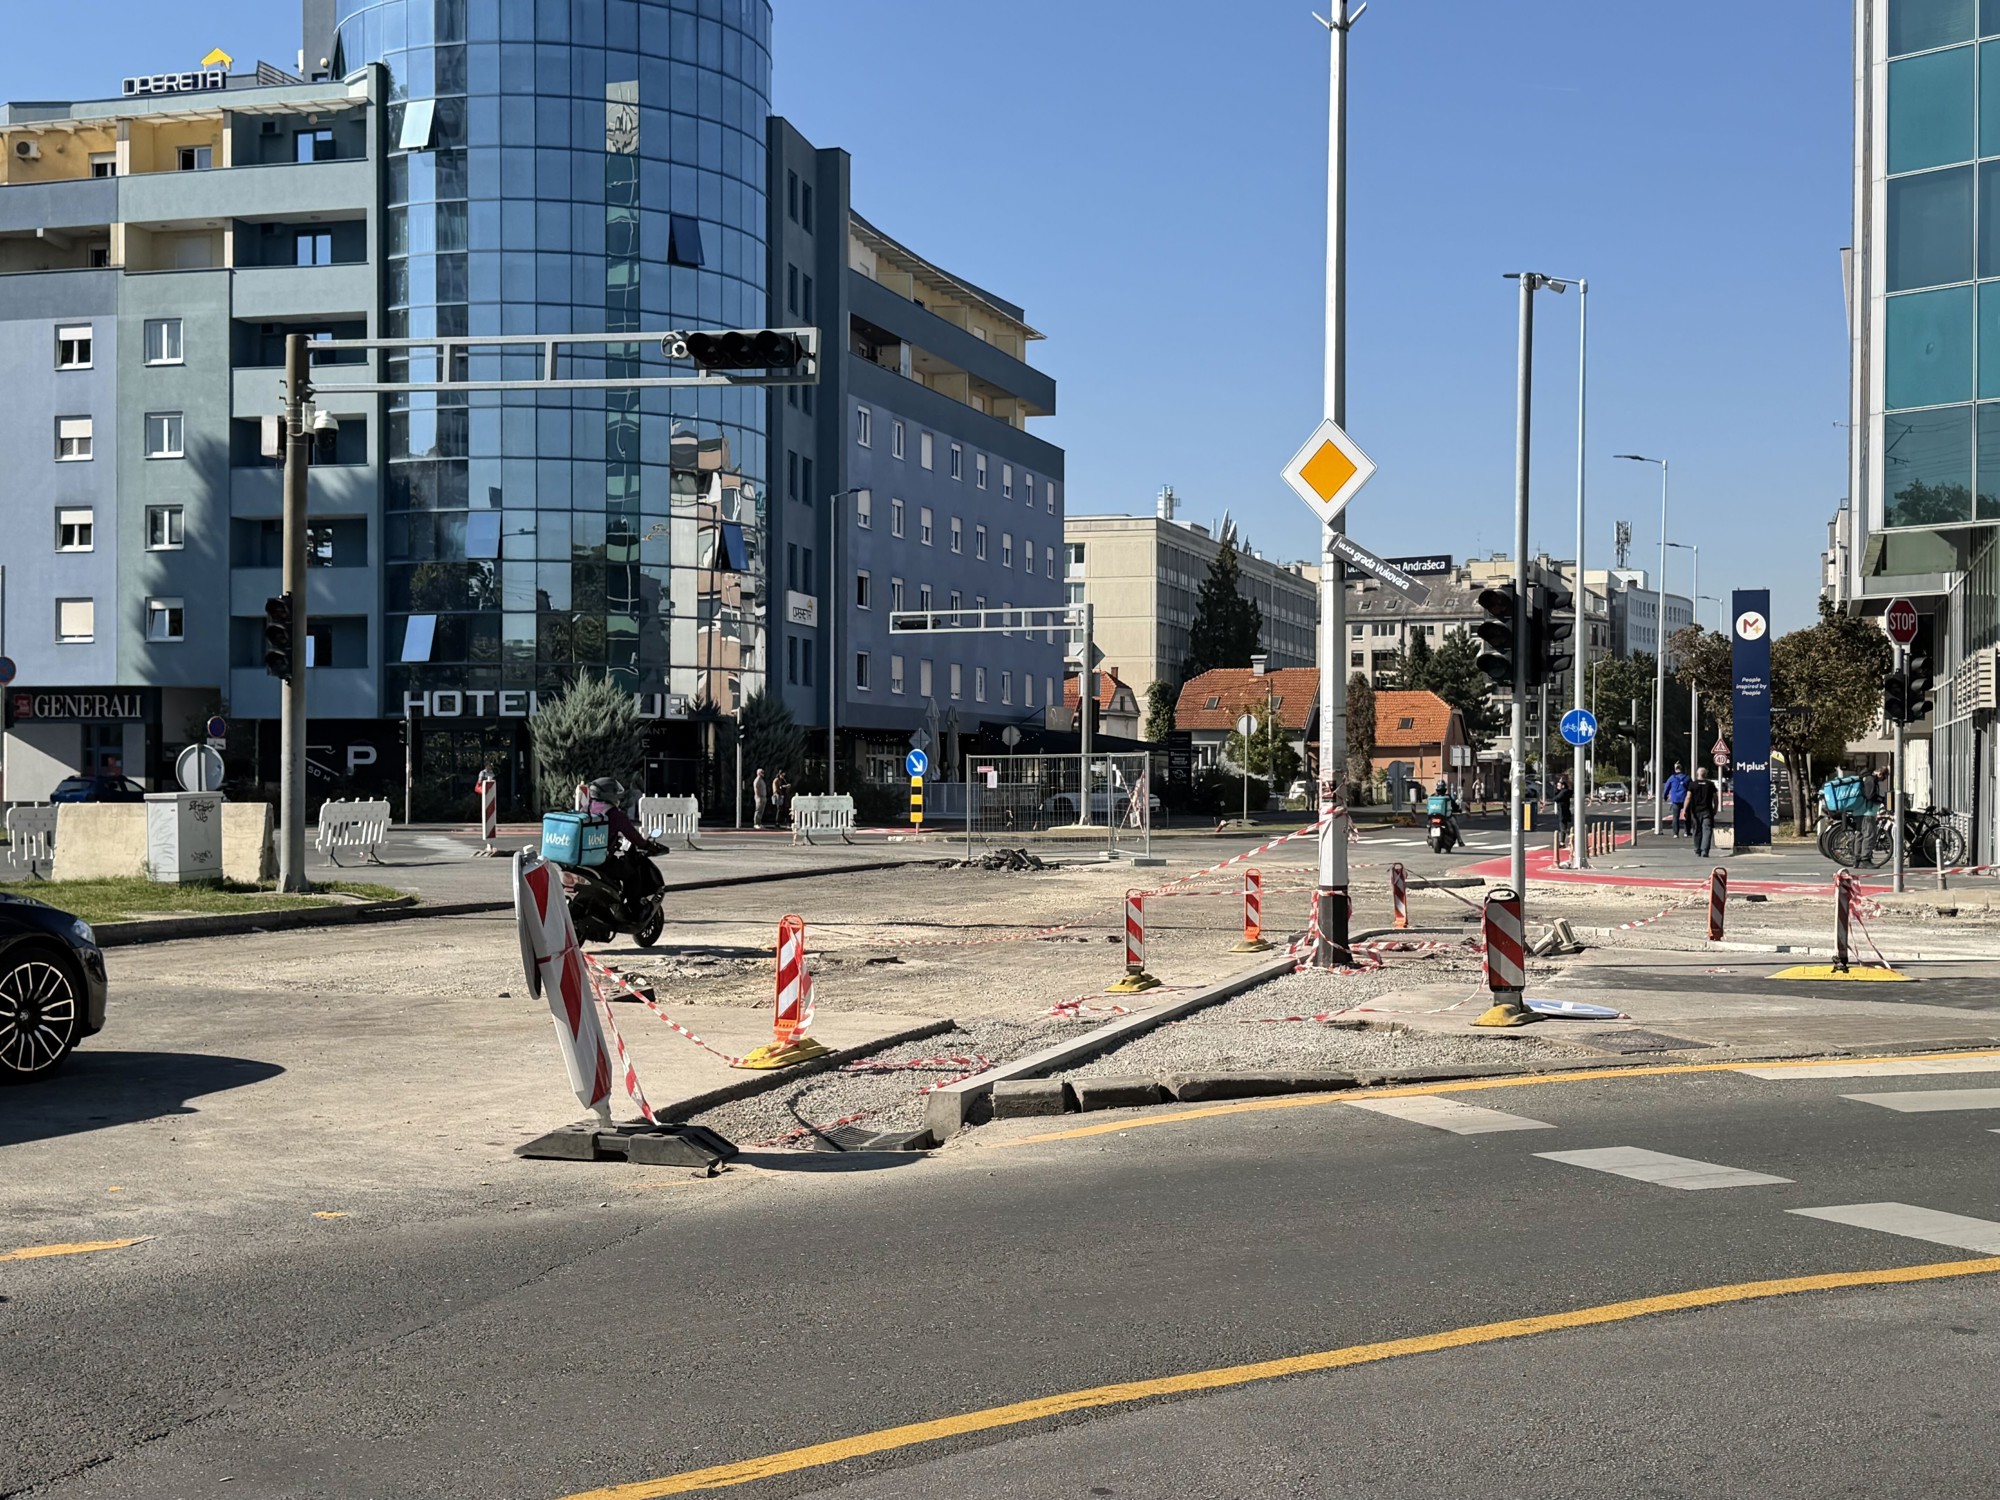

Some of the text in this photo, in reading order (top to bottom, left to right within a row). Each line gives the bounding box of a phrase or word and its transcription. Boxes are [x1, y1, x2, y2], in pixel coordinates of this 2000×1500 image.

[121, 69, 222, 96] OPERETA
[1338, 541, 1410, 591] ULICA grada Vukovara
[1401, 560, 1446, 572] Andrašeca
[1889, 612, 1916, 631] STOP
[34, 694, 142, 718] GENERALI
[403, 690, 543, 718] HOTEL
[347, 745, 378, 776] P
[545, 832, 571, 846] Wolt
[588, 833, 606, 846] Wolt
